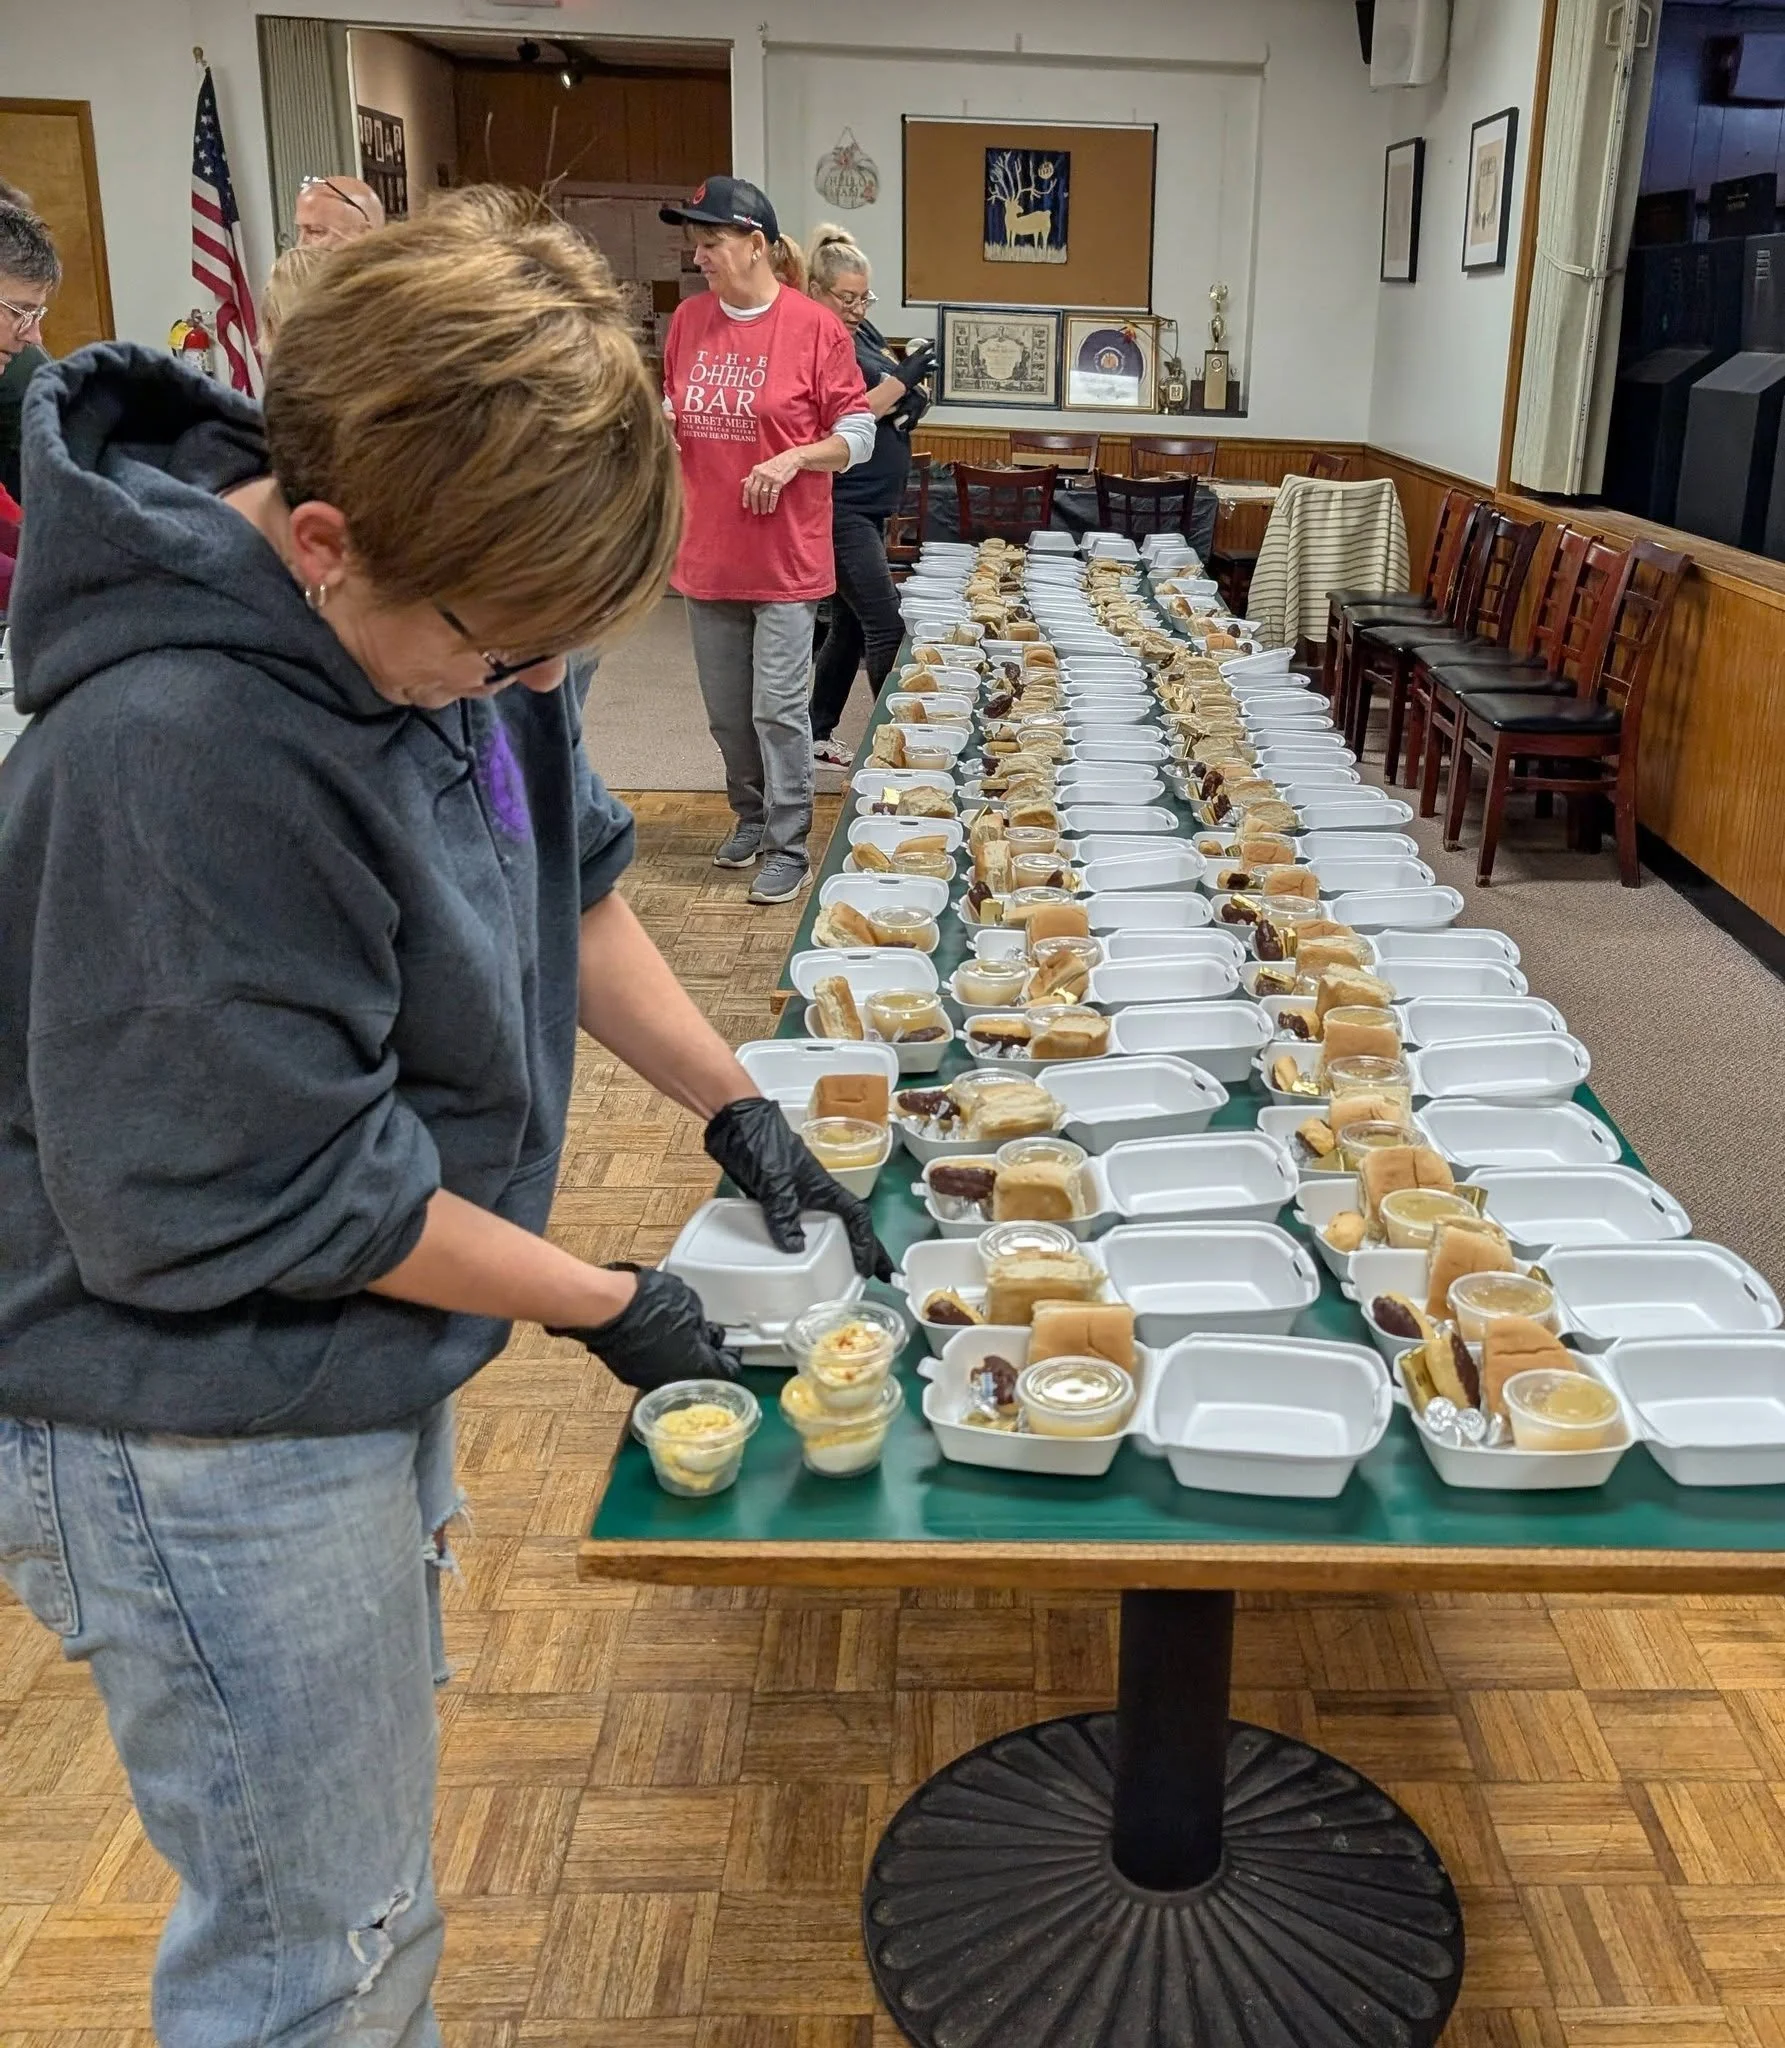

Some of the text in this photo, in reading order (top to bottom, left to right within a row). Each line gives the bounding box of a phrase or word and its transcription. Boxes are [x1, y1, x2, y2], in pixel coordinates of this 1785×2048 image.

[681, 384, 757, 418] BAR
[682, 414, 756, 429] STREET MEET
[709, 432, 730, 440] HEAD
[731, 434, 756, 442] ISLAND
